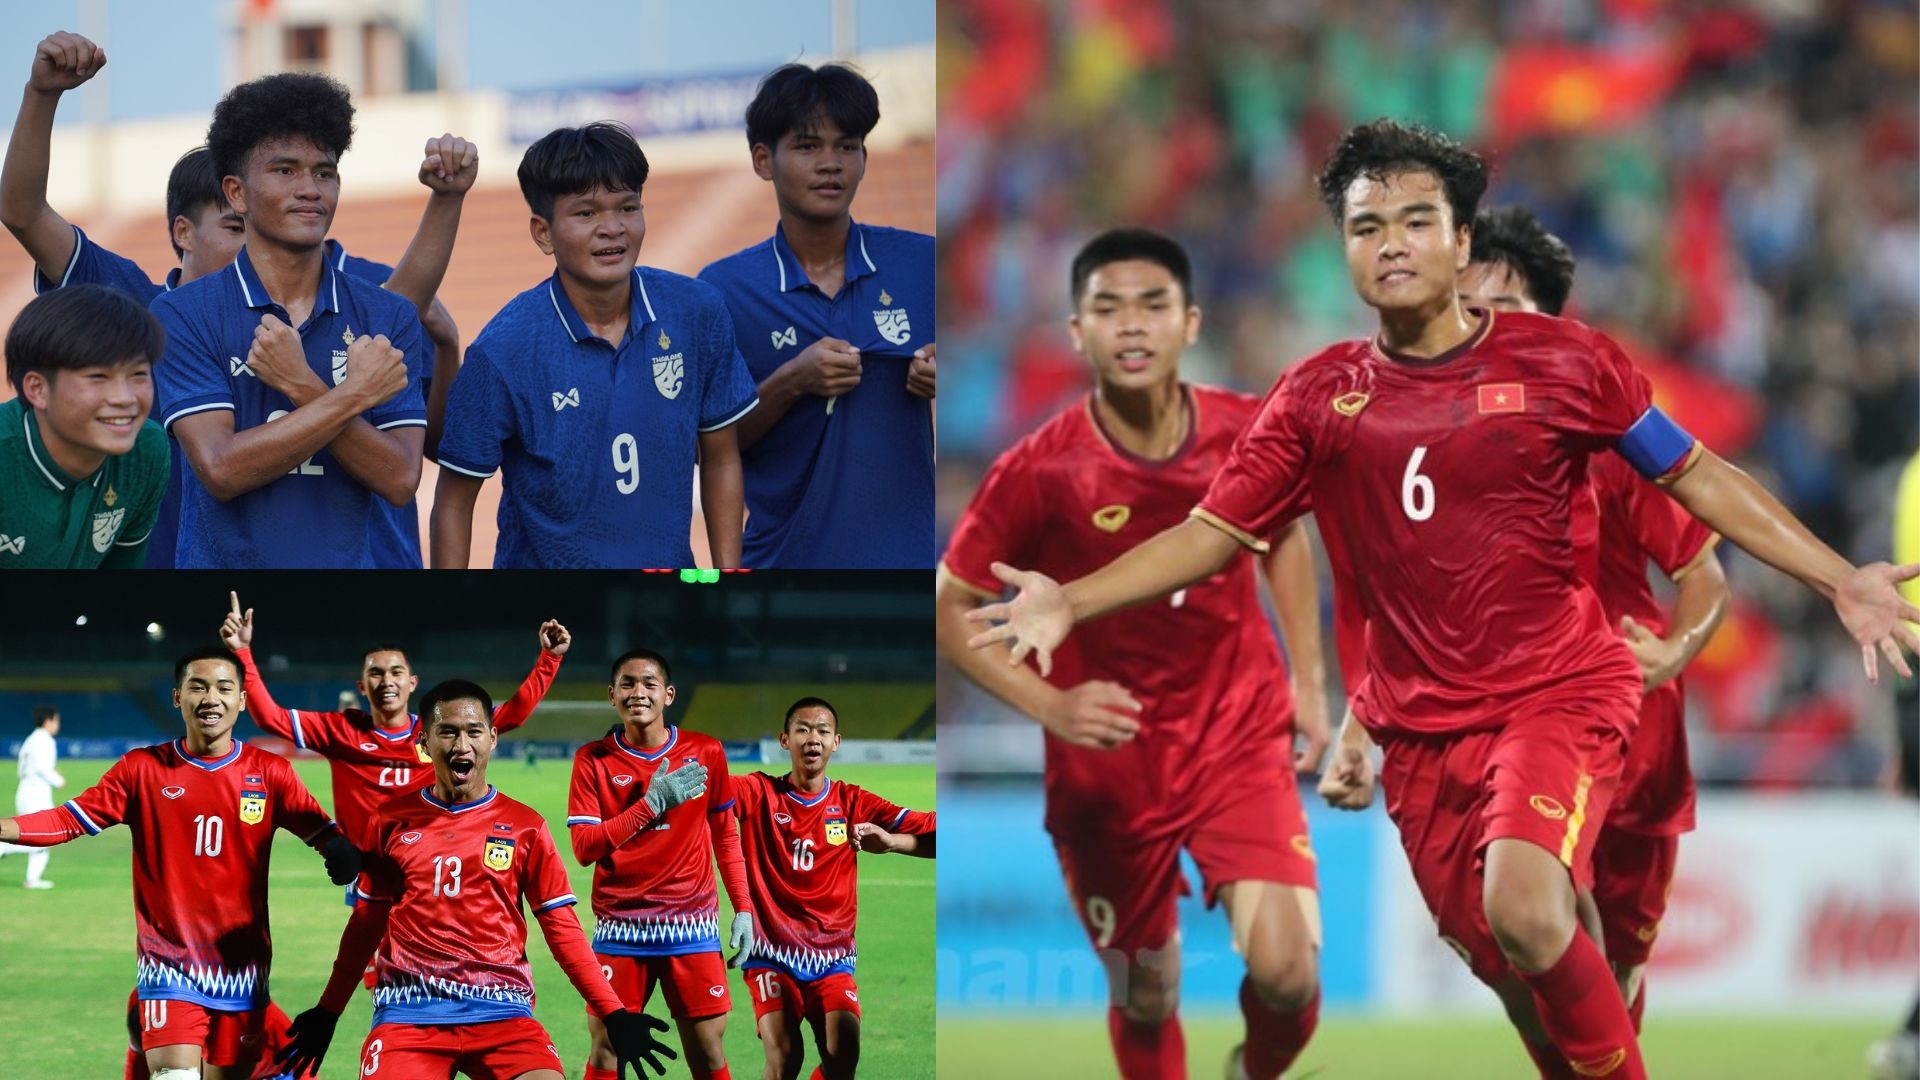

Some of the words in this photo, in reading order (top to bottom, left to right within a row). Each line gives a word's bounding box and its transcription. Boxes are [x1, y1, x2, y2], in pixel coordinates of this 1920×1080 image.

[612, 433, 640, 495] 9
[1402, 446, 1435, 521] 6
[378, 760, 411, 787] 20
[193, 814, 223, 857] 10
[792, 838, 815, 871] 16
[432, 855, 462, 897] 13
[1087, 896, 1117, 947] 9
[755, 971, 781, 1002] 16
[145, 999, 167, 1032] 10
